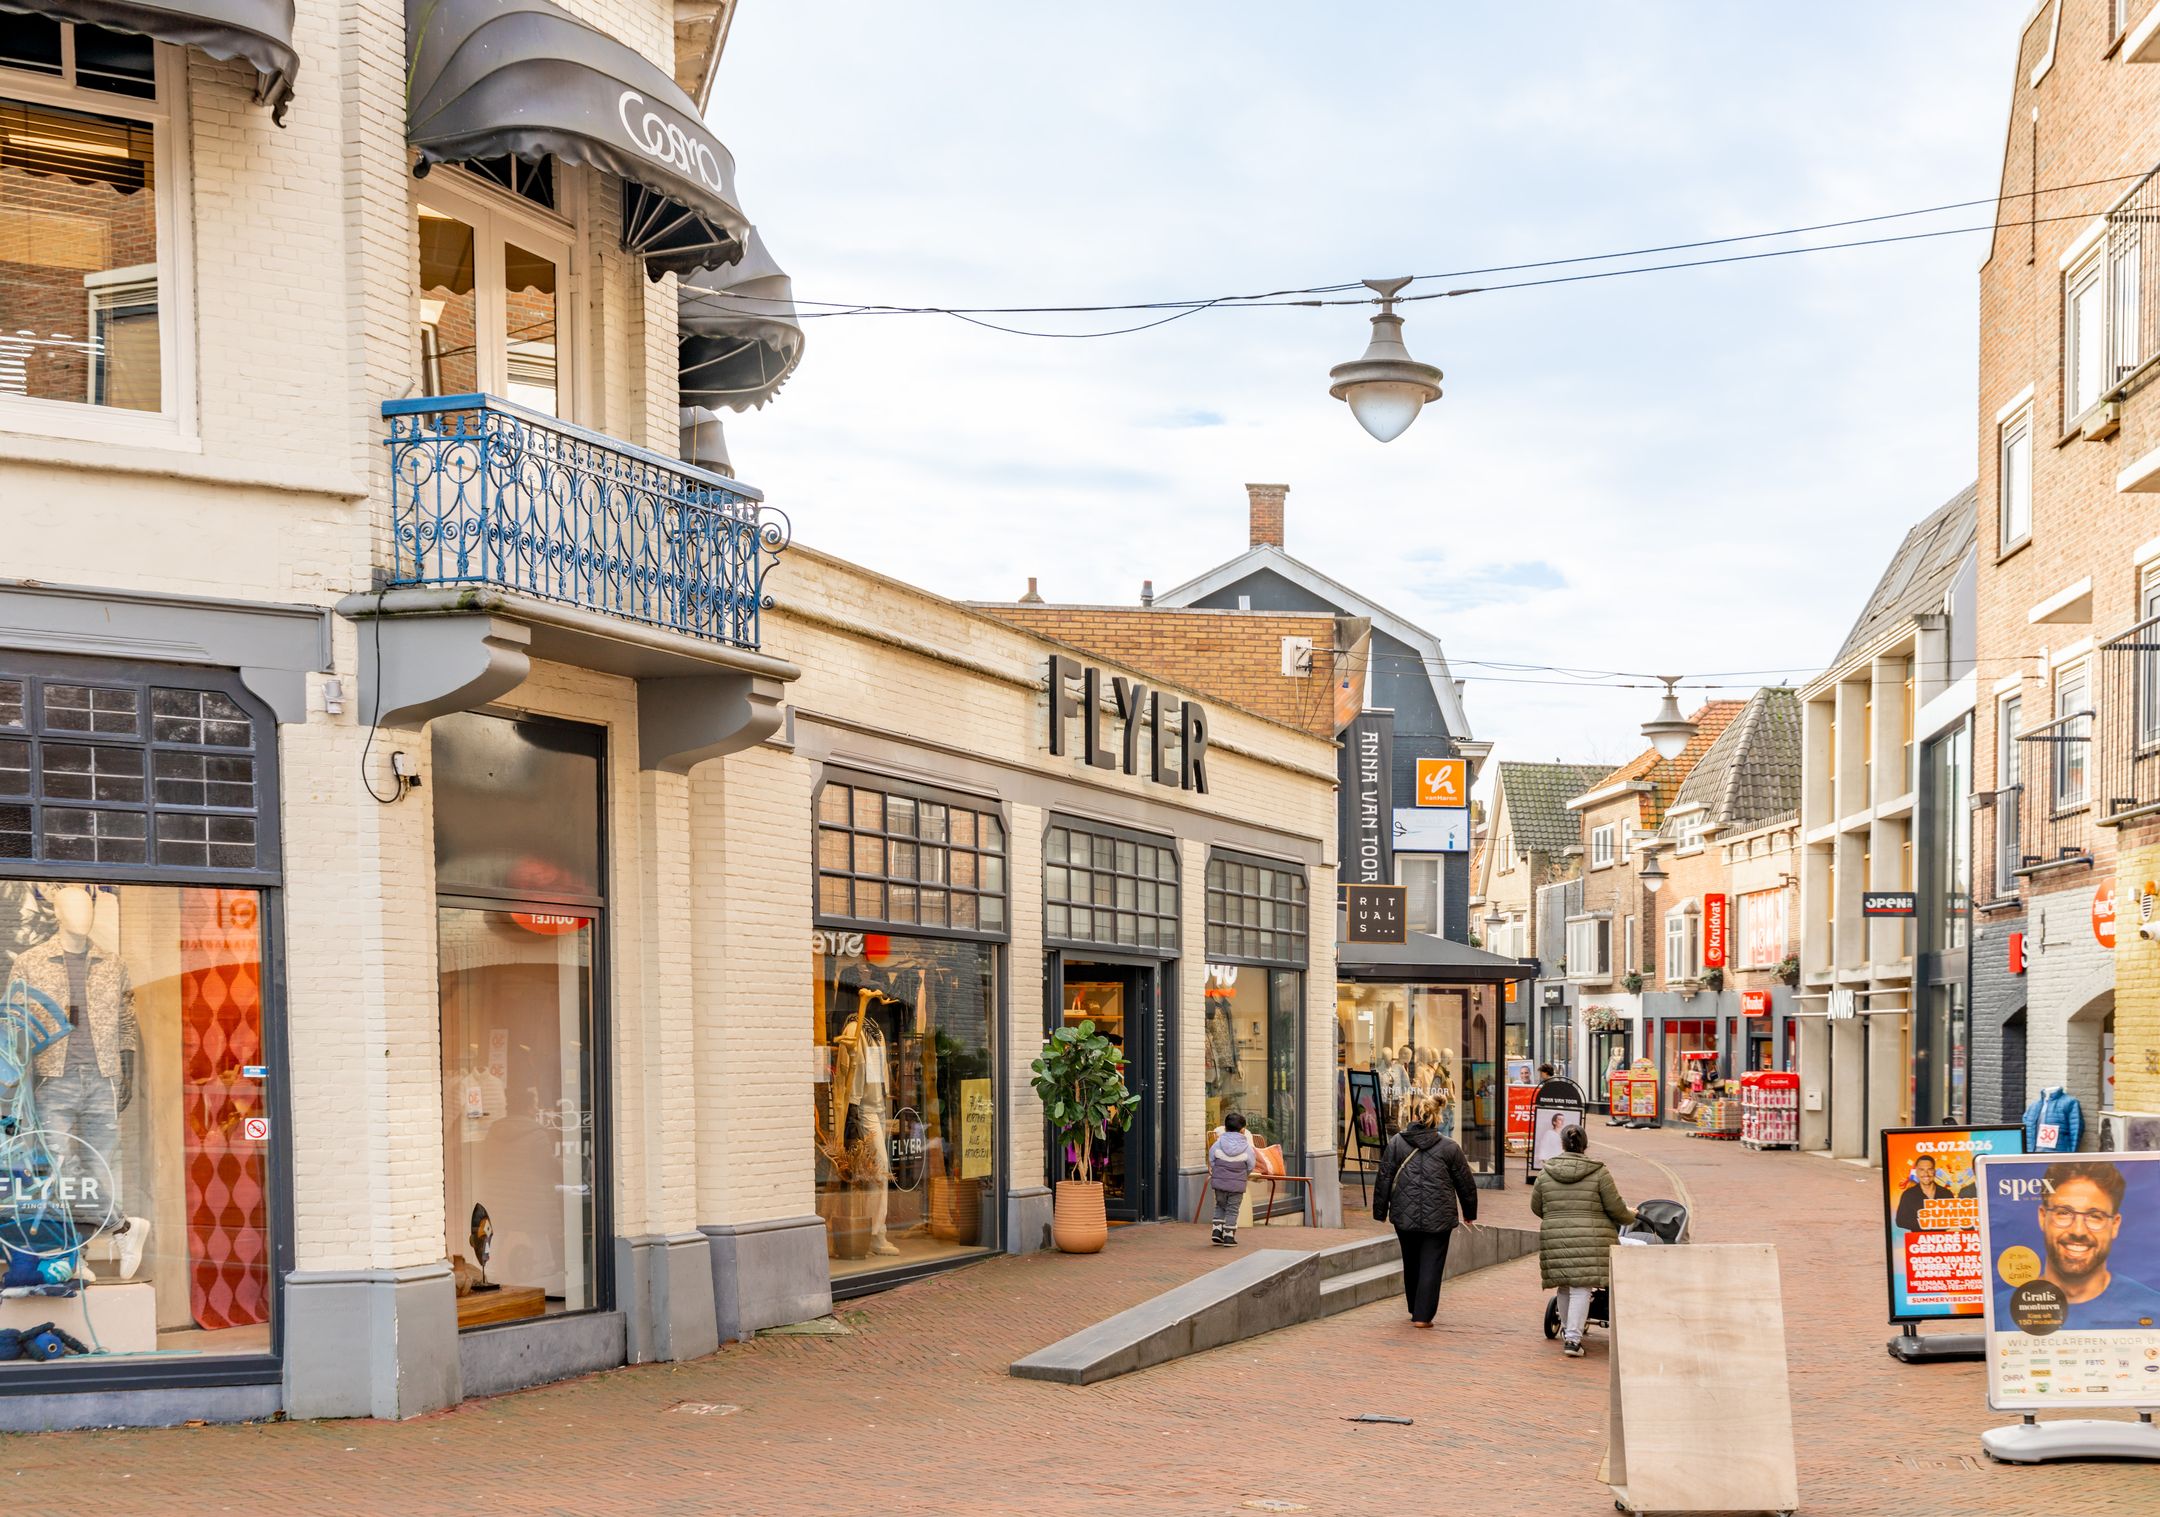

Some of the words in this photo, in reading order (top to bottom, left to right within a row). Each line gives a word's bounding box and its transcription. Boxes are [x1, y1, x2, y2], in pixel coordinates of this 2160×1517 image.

[1049, 655, 1209, 794] FLYER
[1361, 732, 1379, 783] ANNA
[1361, 791, 1378, 829] VAN
[1361, 838, 1378, 883] TOOR
[1709, 901, 1721, 947] Kruidvat
[1827, 989, 1854, 1019] ANWB
[2040, 1129, 2056, 1141] 30
[892, 1139, 922, 1156] FLYER
[1916, 1141, 1993, 1153] 03.07.2026
[1999, 1178, 2056, 1201] spex
[1918, 1232, 1960, 1244] ANDRÉ
[1909, 1243, 1962, 1253] GERARD
[2021, 1291, 2056, 1302] Gratis
[2019, 1303, 2060, 1311] monturen
[2008, 1339, 2029, 1347] WIJ
[2033, 1337, 2107, 1347] DECLAREREN
[2113, 1336, 2142, 1345] VOOR
